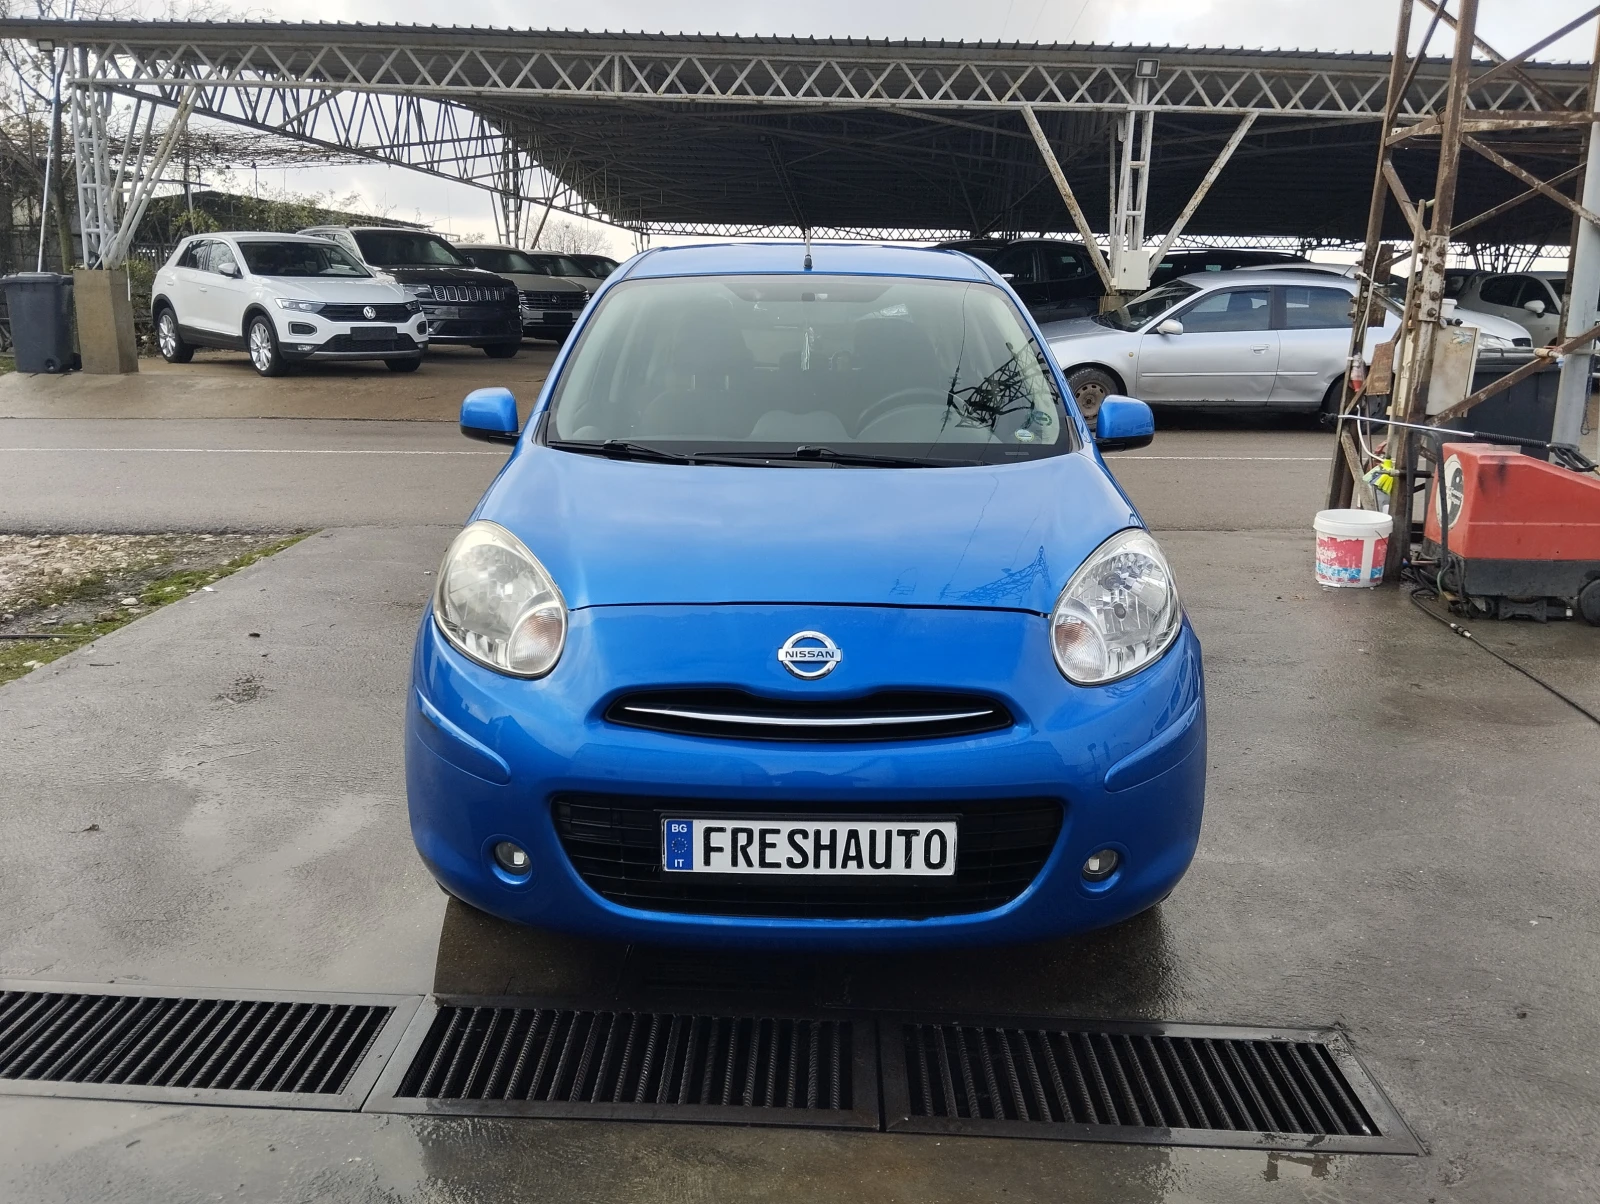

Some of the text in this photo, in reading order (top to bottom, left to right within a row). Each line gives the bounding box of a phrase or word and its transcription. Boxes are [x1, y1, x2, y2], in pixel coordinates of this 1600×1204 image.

[785, 650, 835, 659] NISSAN
[671, 824, 688, 833] BG
[702, 826, 948, 870] FRESHAUTO
[674, 859, 685, 868] IT
